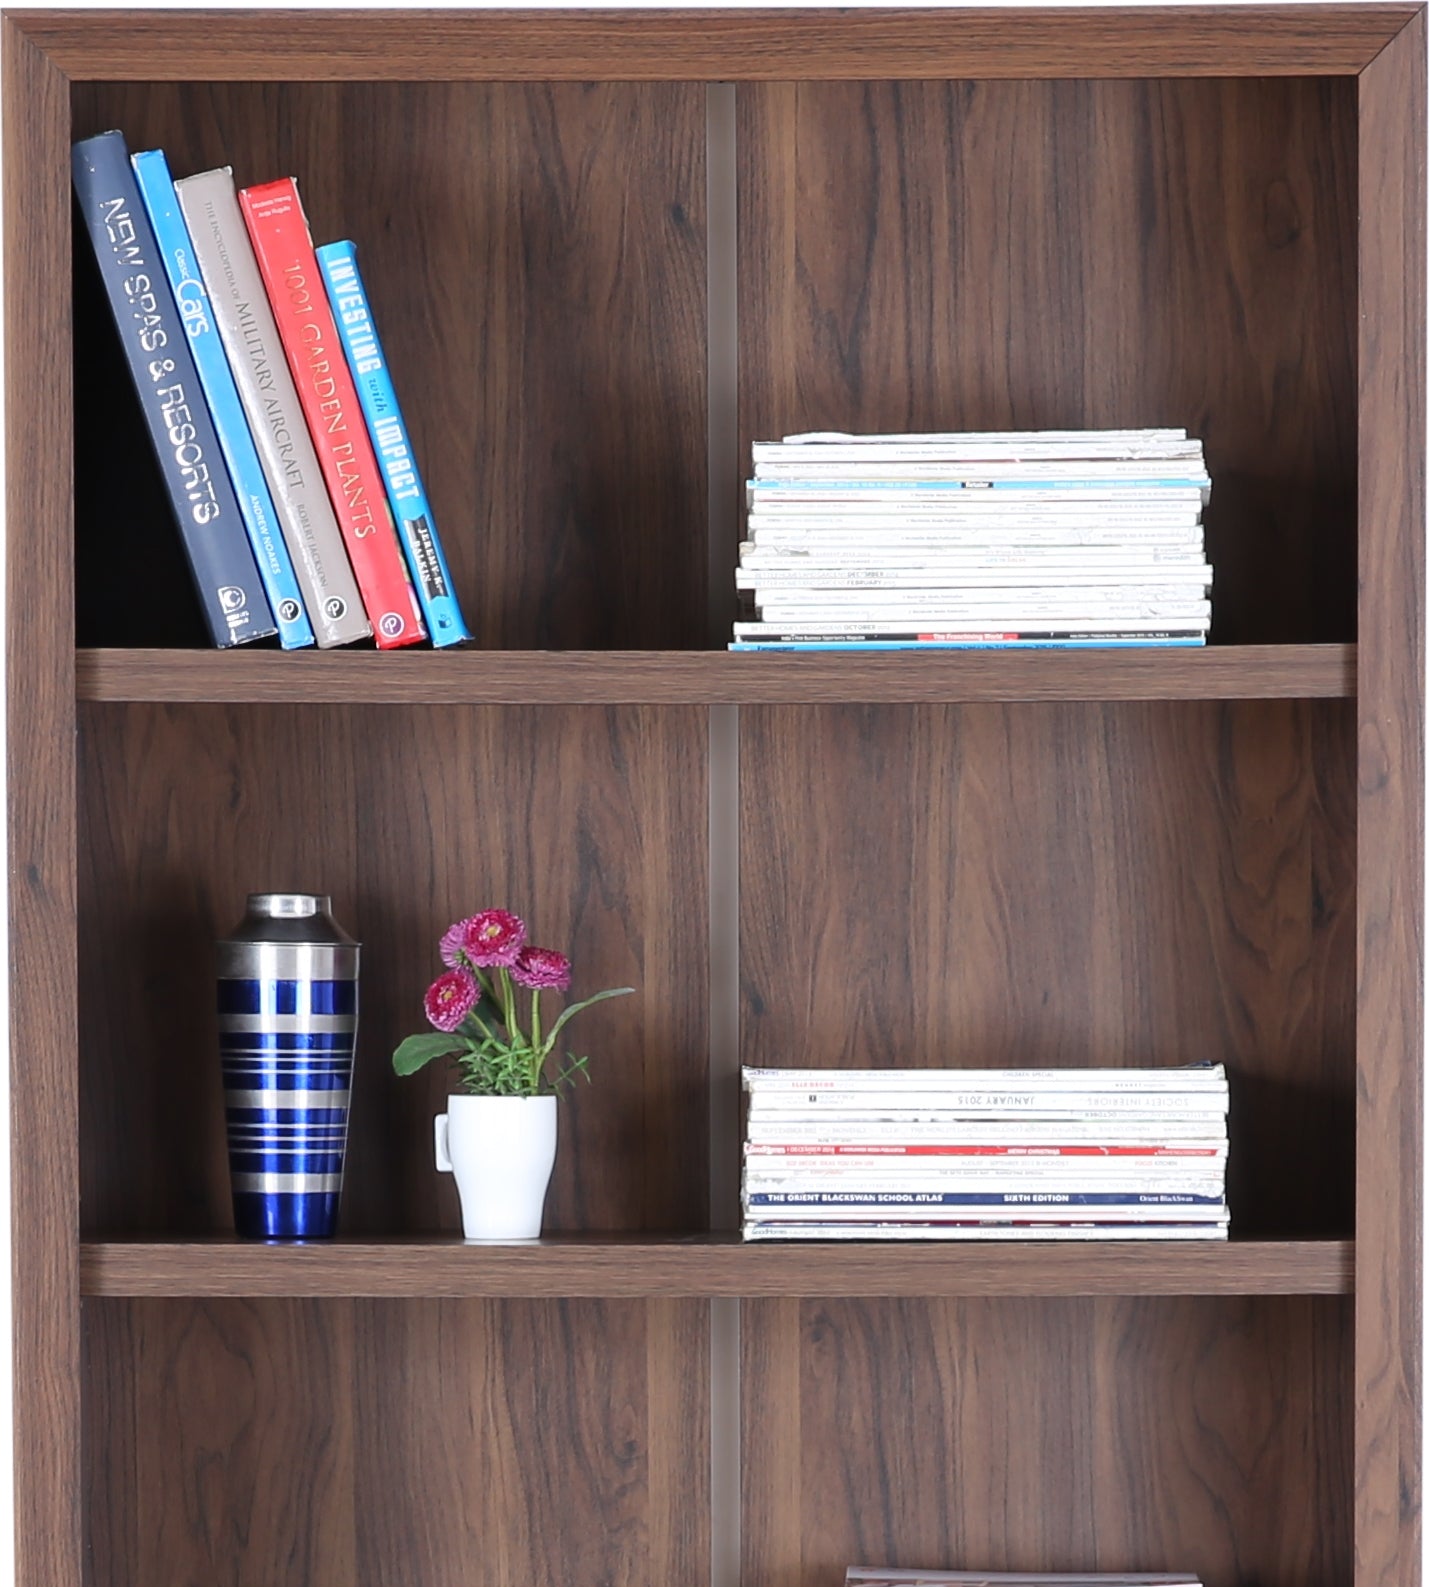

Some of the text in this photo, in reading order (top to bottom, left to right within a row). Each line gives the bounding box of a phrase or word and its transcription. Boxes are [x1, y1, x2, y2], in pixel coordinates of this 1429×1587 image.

[174, 248, 210, 337] Classic Cars
[100, 197, 220, 524] NEW SPAS & RESORTS
[204, 201, 216, 219] THE
[210, 216, 237, 288] ENCYCLOPEDIA
[235, 301, 277, 392] MILITARY
[264, 397, 305, 489] AIRCRAFT
[327, 256, 420, 500] INVESTING with IMPACT
[284, 263, 377, 539] 1001 GARDEN PLANTS
[249, 494, 282, 575] ANDREW NOAKES
[296, 503, 329, 588] ROBERT JACKSON
[412, 540, 432, 583] BALKIN
[417, 528, 440, 575] JEREMY
[933, 633, 945, 641] The
[984, 633, 1004, 641] World
[957, 1095, 1035, 1105] JANUARY 2015
[768, 1194, 943, 1202] THE ORIENT BLACKSWAN SCHOOL ATLAS
[1003, 1194, 1069, 1202] SIXTH EDITION
